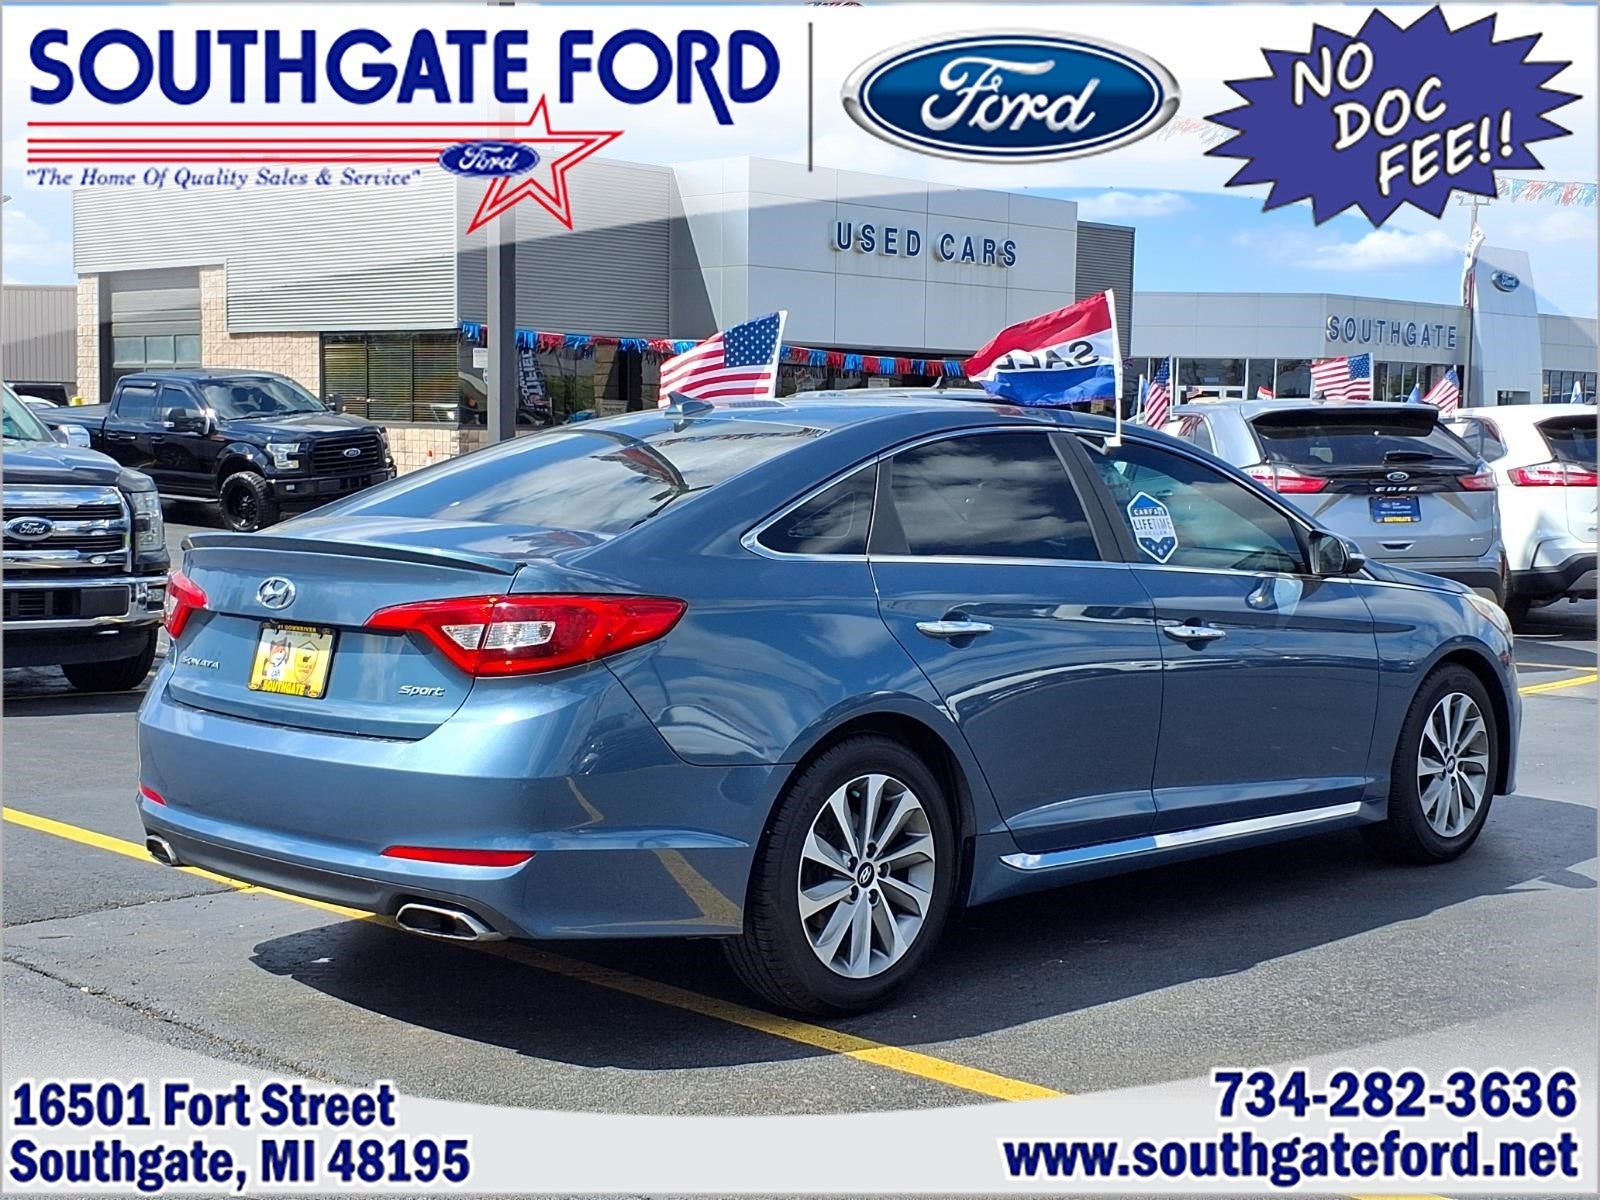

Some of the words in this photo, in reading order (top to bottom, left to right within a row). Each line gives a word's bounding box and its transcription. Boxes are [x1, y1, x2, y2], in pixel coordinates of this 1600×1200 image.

[836, 221, 922, 257] USED
[939, 232, 1017, 268] CARS
[1327, 315, 1457, 348] SOUTHGATE
[19, 522, 46, 535] Ford
[1133, 518, 1172, 530] LIFETIME
[397, 684, 446, 697] Sport
